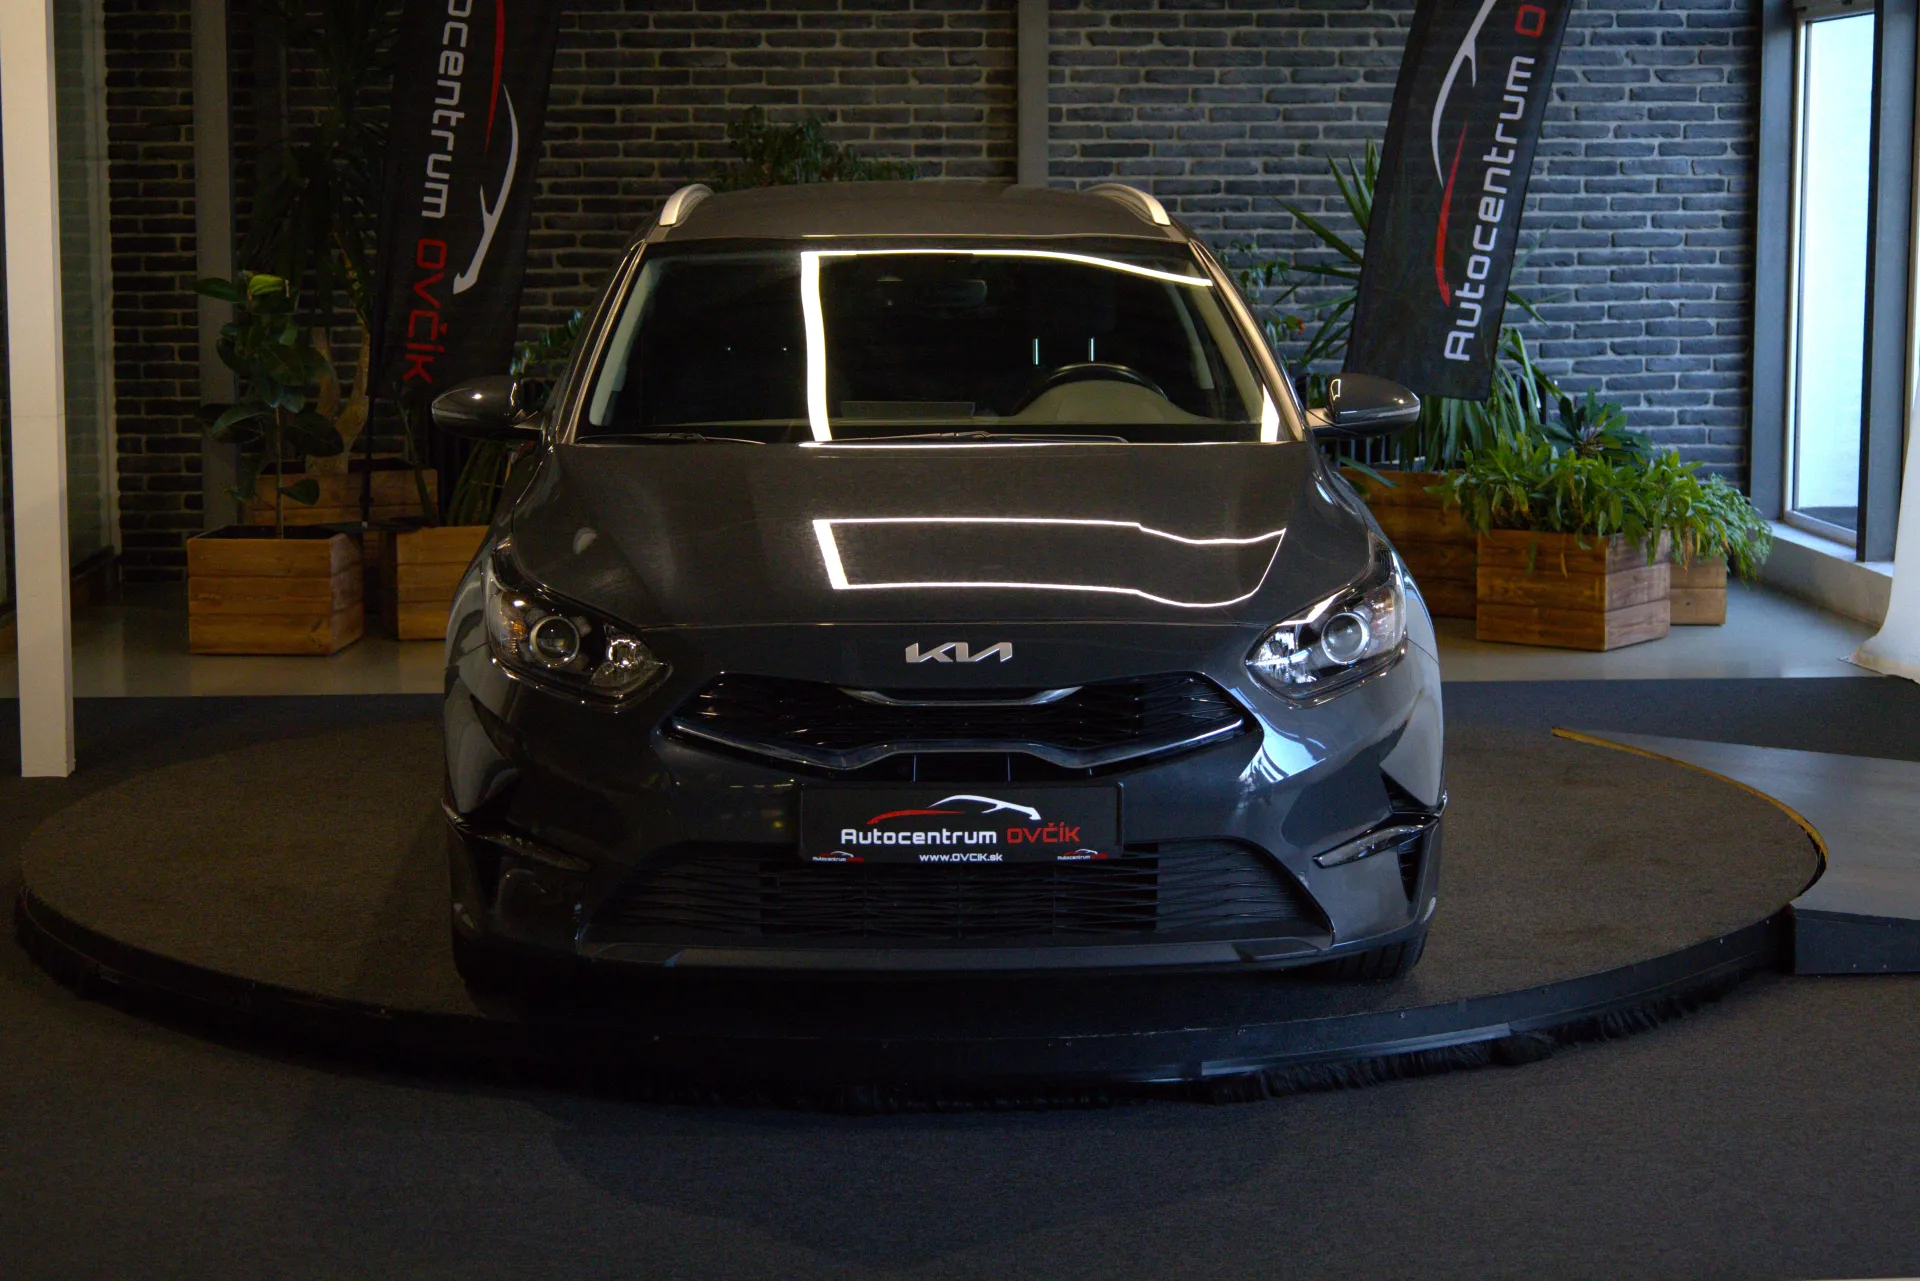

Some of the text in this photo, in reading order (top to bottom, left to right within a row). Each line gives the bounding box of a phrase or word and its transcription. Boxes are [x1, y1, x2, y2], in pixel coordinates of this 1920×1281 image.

[1444, 55, 1536, 361] Autocentrum
[403, 237, 448, 384] OVČÍK
[840, 821, 1081, 845] Autocentrum OVČÍK
[919, 852, 1004, 862] www.OVCIK.sk
